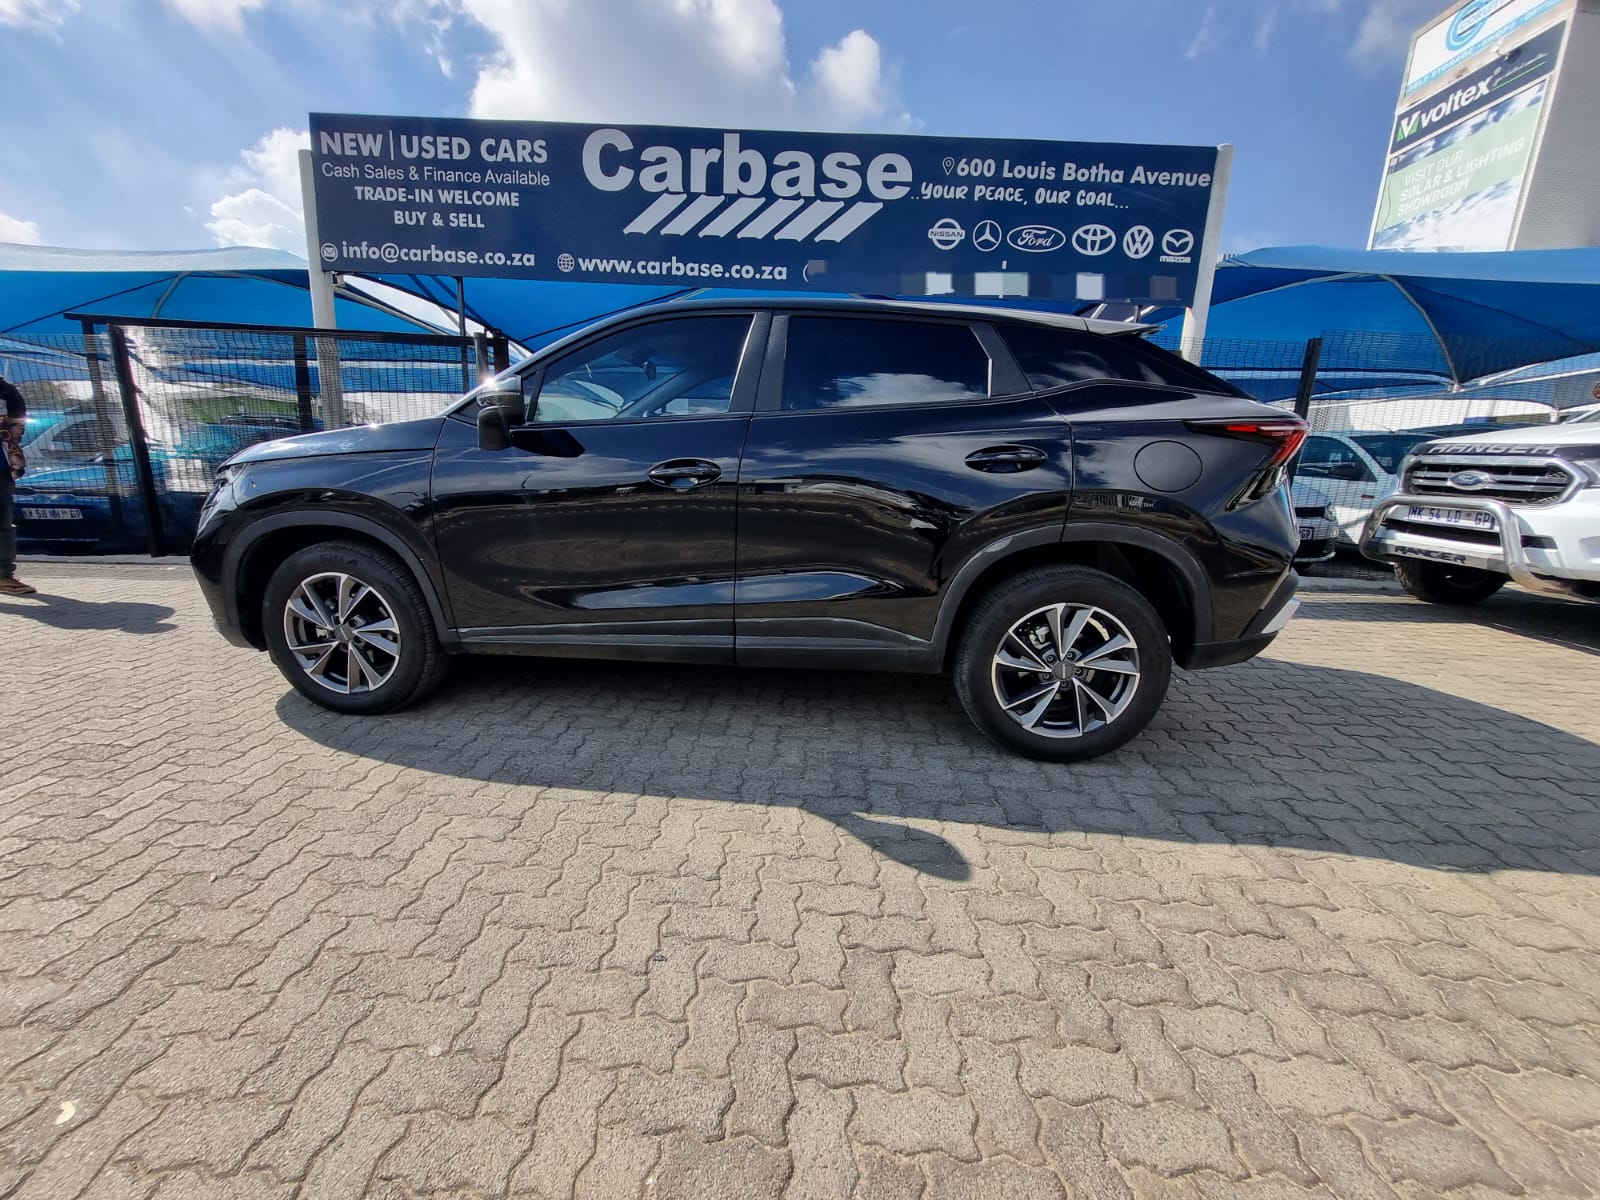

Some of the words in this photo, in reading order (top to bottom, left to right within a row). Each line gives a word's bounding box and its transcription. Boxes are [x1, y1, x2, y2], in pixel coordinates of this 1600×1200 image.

[1421, 75, 1493, 128] voltex
[320, 131, 383, 156] NEW
[400, 135, 471, 161] USED
[480, 138, 548, 163] CARS
[322, 162, 360, 178] Cash
[364, 164, 404, 180] Sales
[408, 166, 419, 181] &
[424, 166, 481, 183] Finance
[484, 168, 550, 186] Available
[581, 128, 913, 200] Carbase
[956, 158, 995, 177] 600
[1003, 159, 1056, 181] Louis
[1062, 162, 1124, 184] Botha
[1129, 165, 1211, 187] Avenue
[1401, 174, 1442, 200] SOLAR
[1456, 137, 1525, 177] LIGHTING
[1404, 162, 1435, 185] VISIT
[1436, 150, 1464, 172] OUR
[354, 186, 433, 204] TRADE-IN
[438, 189, 520, 207] WELCOME
[1035, 189, 1071, 205] OUR
[1397, 178, 1470, 217] SHOWROOM
[394, 210, 428, 226] BUY
[432, 213, 444, 227] &
[449, 213, 485, 228] SELL
[1017, 229, 1055, 247] Ford
[342, 241, 535, 267] info@carbase.co.za
[577, 256, 787, 281] www.carbase.co.za
[1428, 443, 1559, 455] RANGER
[1474, 511, 1491, 525] GP
[1395, 545, 1467, 564] RANGER
